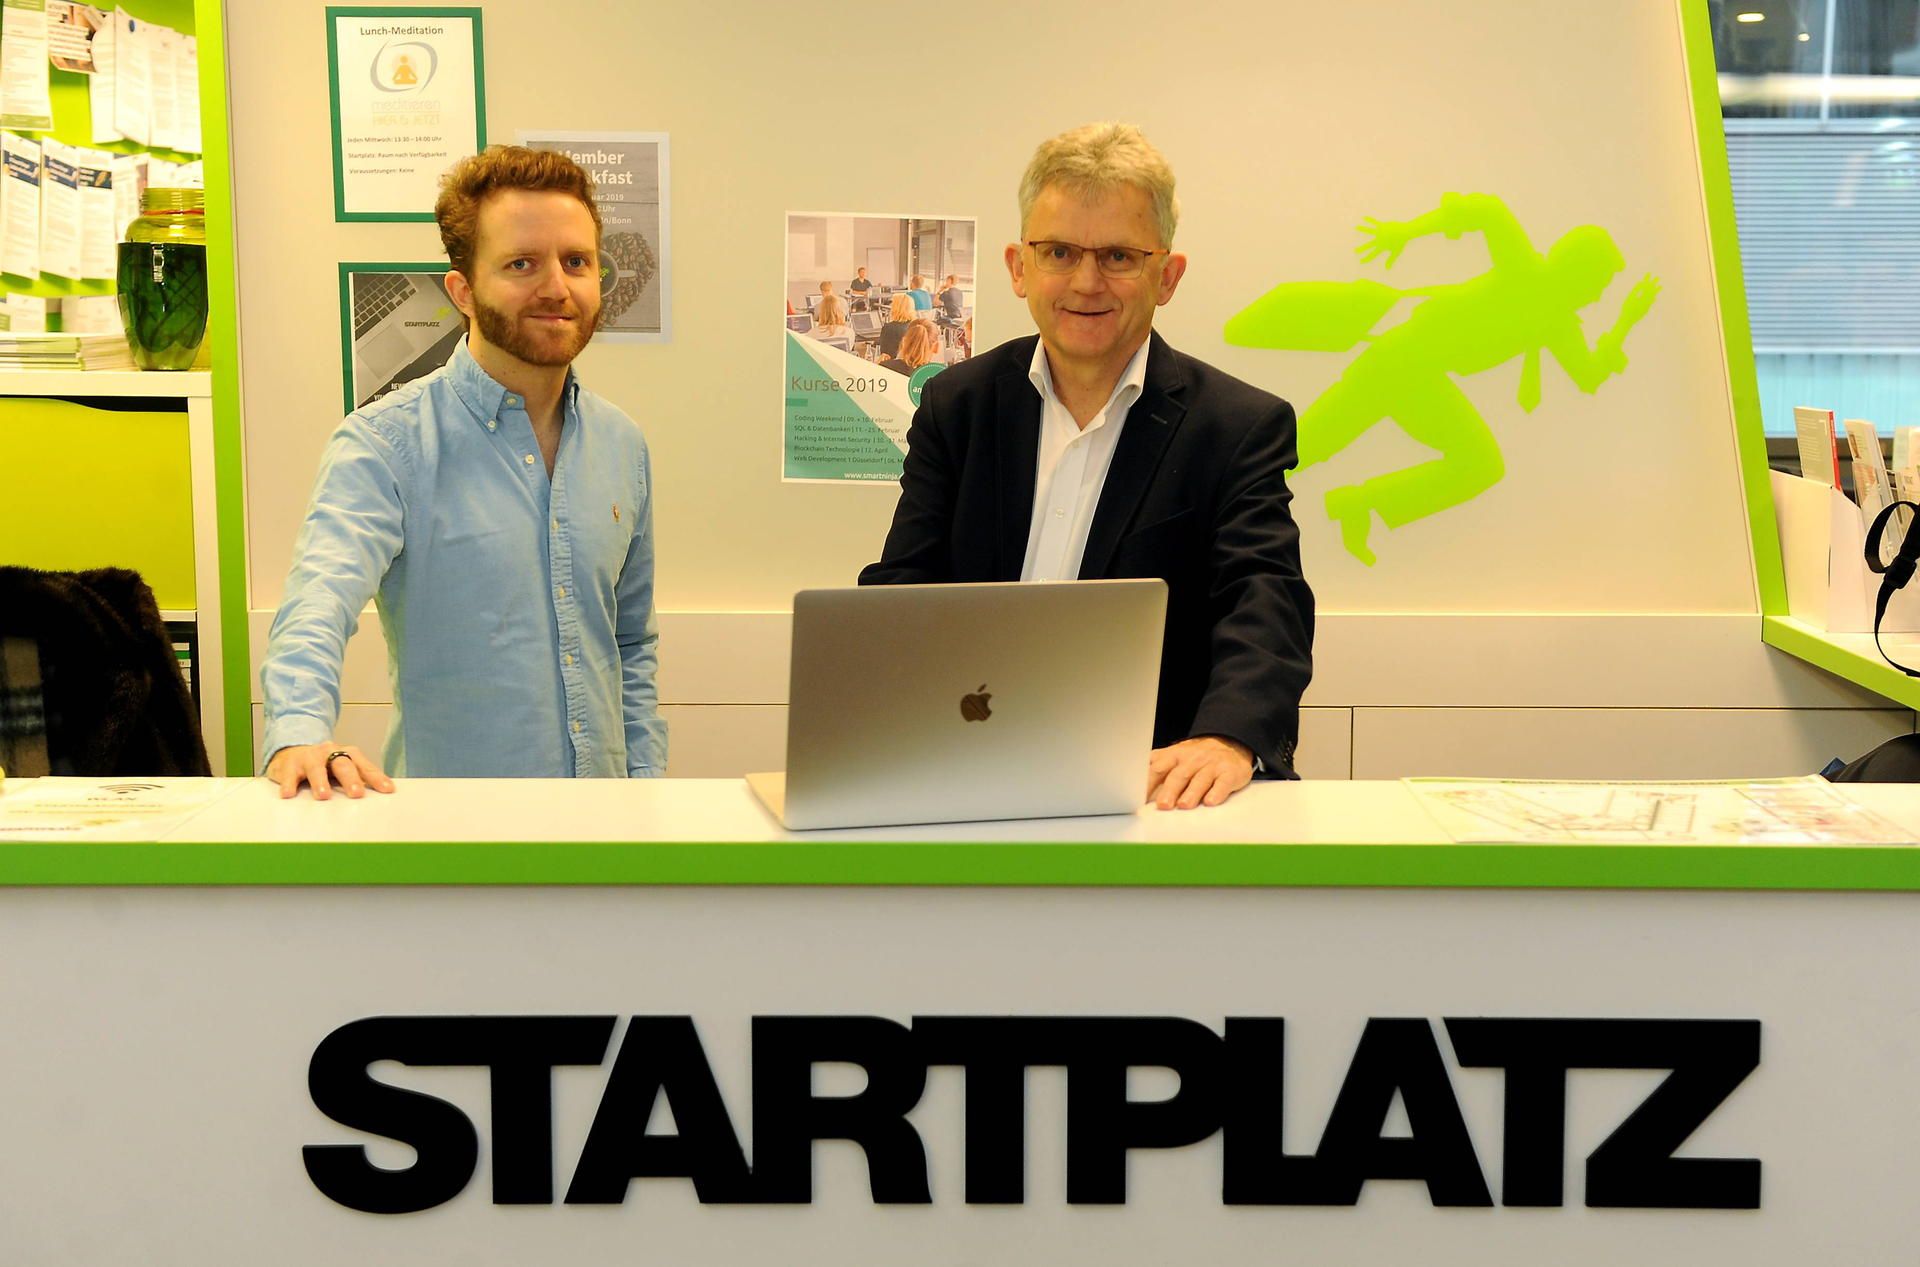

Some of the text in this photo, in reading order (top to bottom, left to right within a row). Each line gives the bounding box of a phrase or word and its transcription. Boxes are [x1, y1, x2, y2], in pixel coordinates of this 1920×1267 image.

[360, 26, 444, 35] Lunch-Meditation
[591, 169, 633, 185] kfast
[606, 193, 624, 201] 2019
[791, 375, 888, 393] Kurse 2019
[844, 472, 900, 480] www.smartninja.
[302, 1014, 1762, 1214] STARTPLATZ
